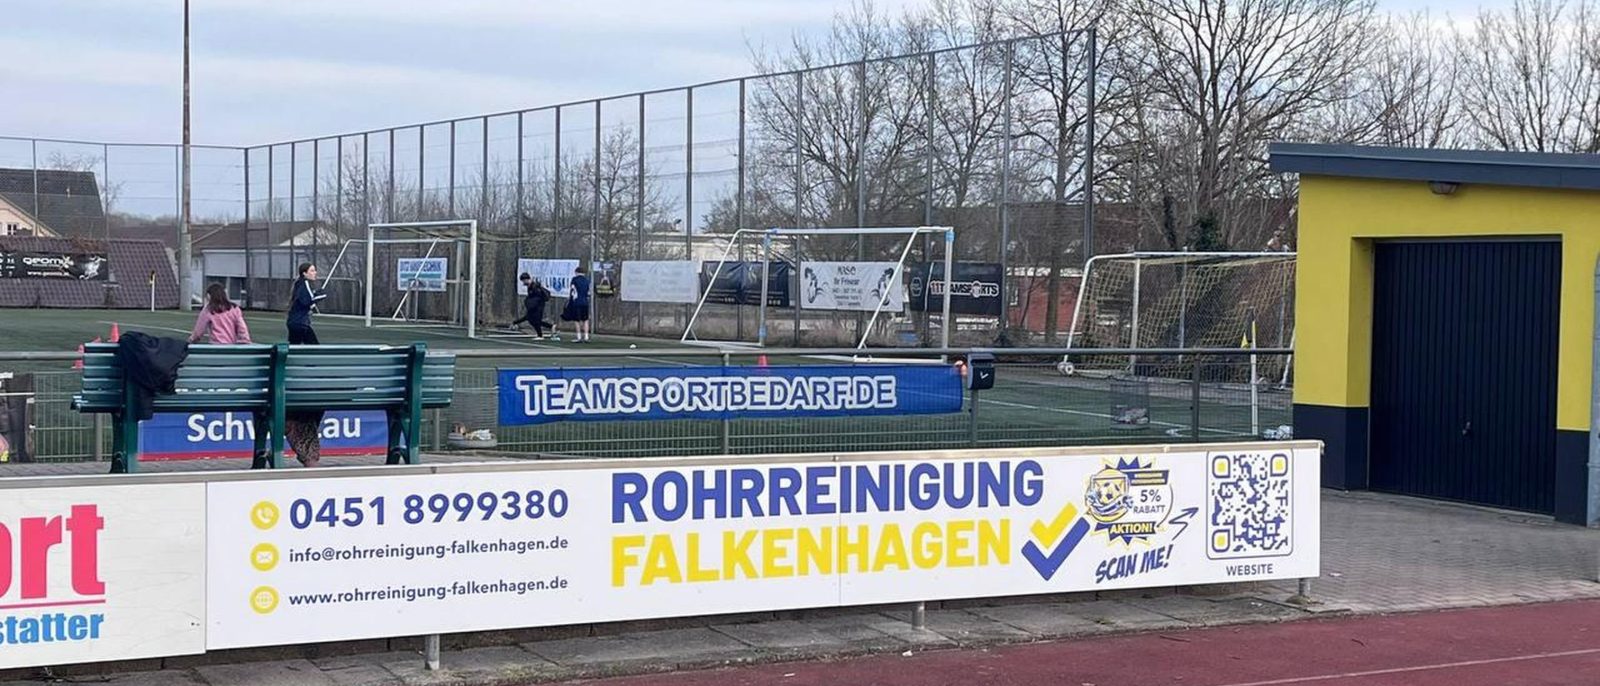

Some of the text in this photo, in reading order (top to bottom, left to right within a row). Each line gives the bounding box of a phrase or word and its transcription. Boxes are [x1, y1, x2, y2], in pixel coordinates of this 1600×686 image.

[931, 282, 998, 295] 11TAMSPORTS
[515, 374, 897, 416] TEAMSPORTBEDARF.DE
[611, 459, 1044, 524] ROHRREINIGUNG
[1140, 489, 1161, 503] 5%
[289, 489, 569, 530] 0451 8999380
[1133, 504, 1166, 514] RABATT
[1110, 523, 1153, 534] AKTION!
[0, 504, 105, 600] rt
[289, 535, 569, 563] info@rohrreinigung-falkenhagen.de
[611, 518, 1011, 588] FALKENHAGEN
[1095, 544, 1174, 584] SCAN ME!
[1225, 563, 1275, 577] WEBSITE
[289, 576, 569, 605] www.rohrreinigung-falkenhagen.de
[0, 612, 104, 645] tatter
